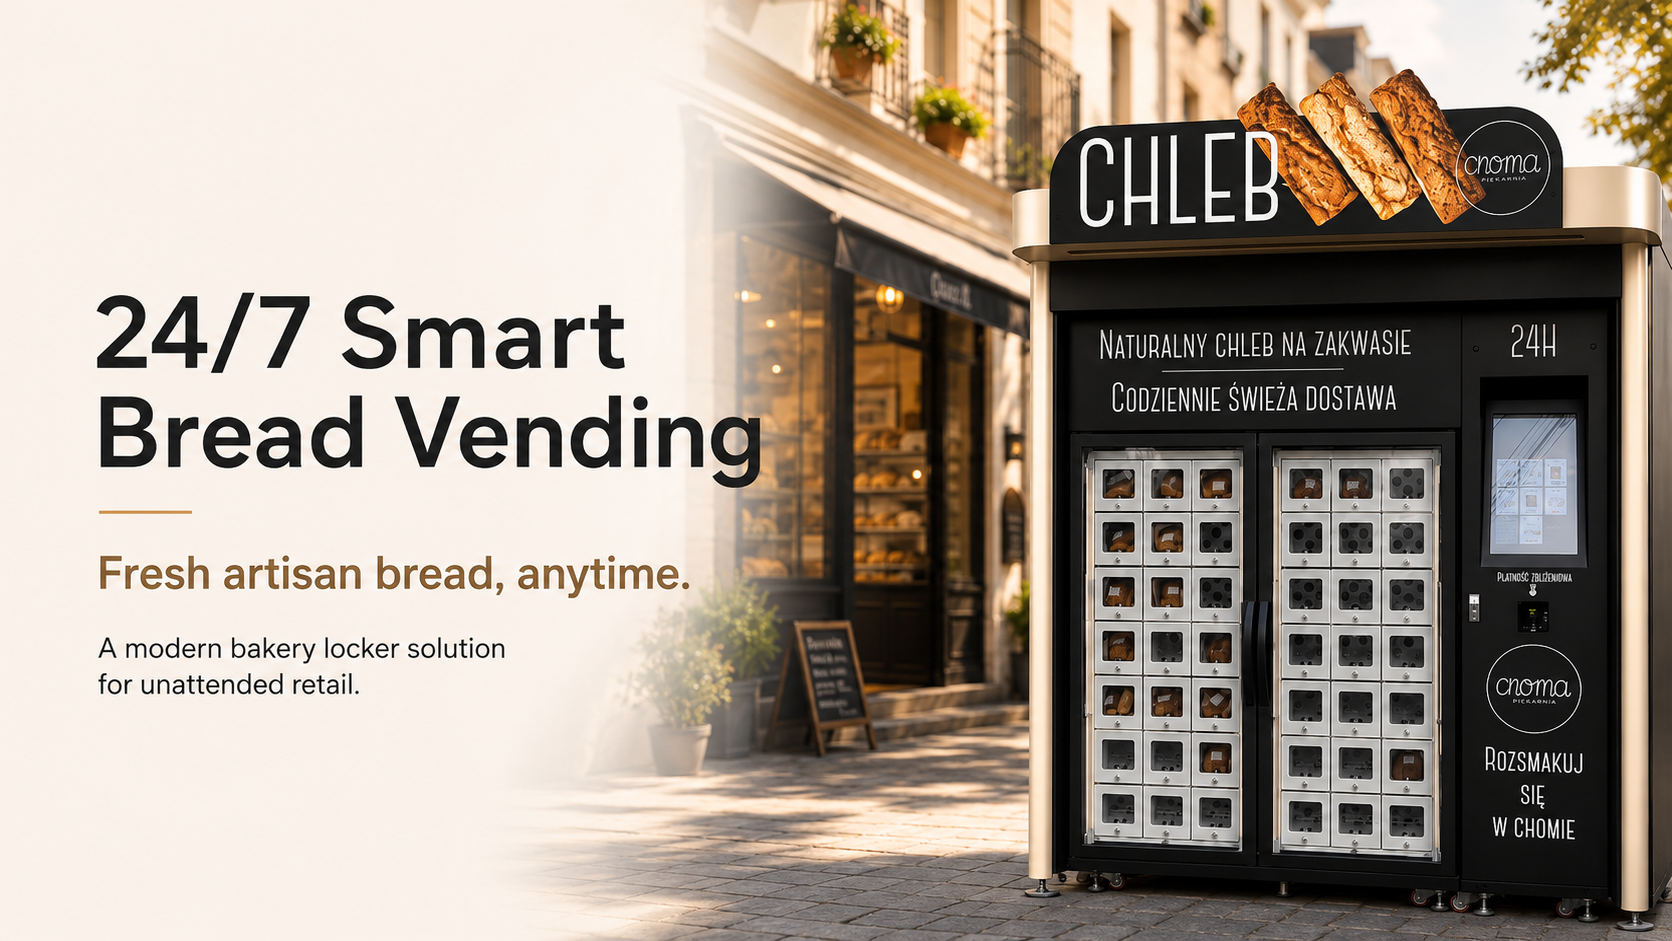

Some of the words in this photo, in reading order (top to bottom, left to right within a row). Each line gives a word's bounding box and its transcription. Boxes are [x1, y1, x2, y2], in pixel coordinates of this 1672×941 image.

[1079, 131, 1280, 228] CHLEB
[1101, 330, 1207, 359] NATURALNY
[1216, 332, 1273, 357] CHLEB
[1283, 332, 1306, 356] NA
[1315, 330, 1411, 356] ZAKWASIE
[1512, 324, 1555, 357] 24H
[1113, 382, 1220, 412] CODZIENNIE
[1229, 382, 1297, 411] ŚWIEŻA
[1306, 385, 1396, 411] DOSTAWA
[1486, 746, 1582, 773] ROZSMAKUJ
[1521, 785, 1545, 809] SIĘ
[1493, 817, 1507, 836] W
[1515, 817, 1575, 840] CHOMIE
